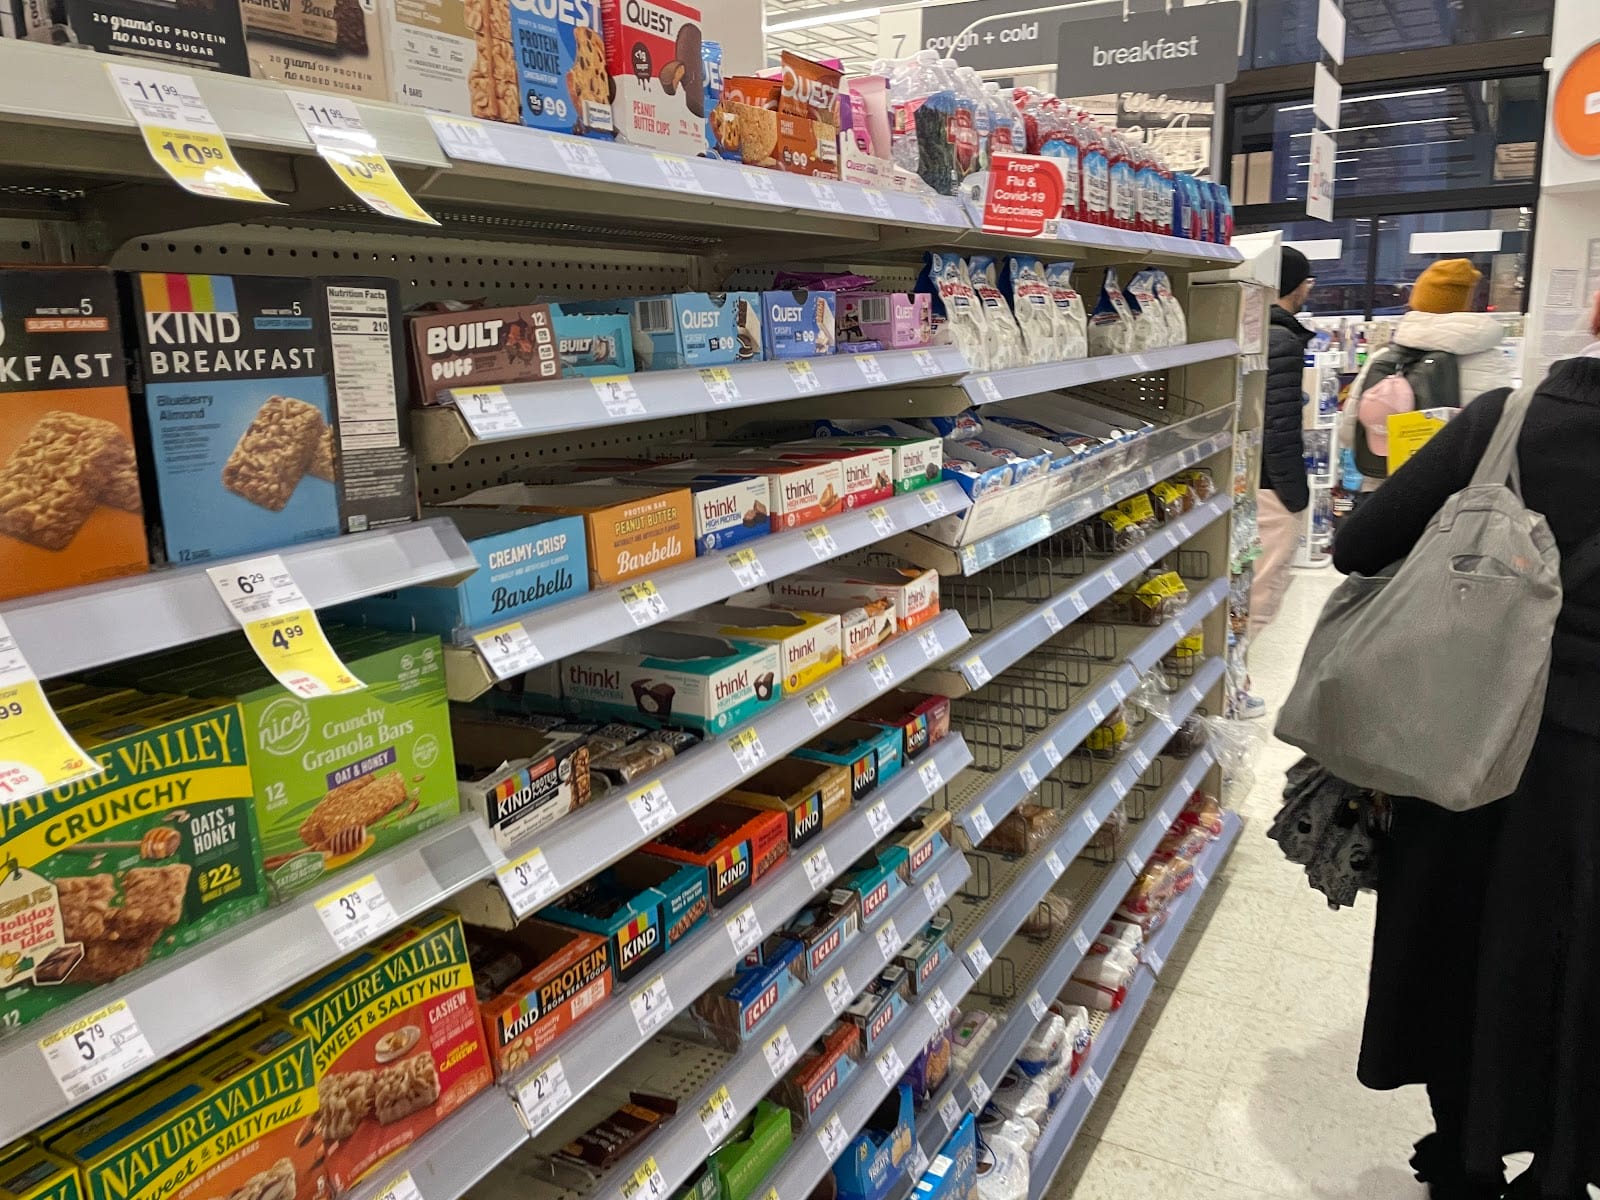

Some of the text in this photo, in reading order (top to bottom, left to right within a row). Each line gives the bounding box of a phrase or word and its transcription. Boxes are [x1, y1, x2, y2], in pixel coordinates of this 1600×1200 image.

[93, 12, 226, 45] 20 grams OF PROTEIN
[626, 0, 673, 35] QUEST
[112, 31, 214, 57] no ADDED SUGAR
[519, 29, 558, 50] PROTEIN
[926, 31, 980, 53] cough
[1000, 22, 1039, 44] cold
[1092, 35, 1199, 68] breakfast
[283, 56, 316, 72] grams
[333, 67, 372, 82] PROTEIN
[522, 48, 561, 76] COOKIE
[300, 75, 330, 87] ADDED
[334, 80, 362, 92] SUGAR
[402, 84, 423, 99] 4 BARS
[633, 101, 656, 117] PEANUT
[633, 115, 671, 136] BUTTER CUPS
[994, 188, 1046, 203] Covid-19
[1006, 176, 1037, 188] Flu &
[992, 203, 1044, 217] Vaccines
[80, 298, 93, 316] 5
[329, 288, 385, 300] Nutrition Facts
[292, 301, 302, 316] 5
[682, 310, 720, 329] QUEST
[772, 304, 803, 322] QUEST
[145, 312, 241, 344] KIND
[372, 321, 388, 333] 210
[427, 320, 503, 355] BUILT
[559, 338, 593, 354] BUILT
[0, 353, 112, 382] KFAST
[150, 348, 316, 375] BREAKFAST
[431, 358, 473, 381] PUFF
[157, 395, 214, 408] Blueberry
[160, 408, 205, 421] Almond
[846, 464, 870, 483] think!
[786, 478, 814, 500] think!
[615, 507, 677, 536] PEANUT BUTTER
[624, 500, 667, 518] PROTEIN BAR
[703, 496, 737, 520] think!
[705, 512, 743, 529] HIGH PROTEIN
[179, 548, 191, 563] 12
[489, 534, 567, 571] CREAMY-CRISP
[617, 536, 681, 575] Barebells
[491, 567, 573, 614] Barebells
[907, 585, 926, 606] think!
[850, 618, 876, 645] think!
[788, 637, 816, 663] think!
[569, 665, 620, 689] think!
[715, 669, 749, 700] think!
[322, 706, 386, 741] Crunchy
[302, 719, 415, 772] Granola Bars
[908, 729, 927, 749] KIND
[0, 713, 231, 838] ATURE VALLEY
[335, 752, 389, 785] OAT & HONEY
[532, 770, 558, 788] PROTEIN
[854, 767, 875, 792] KIND
[265, 782, 286, 802] 12
[498, 787, 532, 820] KIND
[45, 777, 192, 848] CRUNCHY
[190, 808, 225, 837] OATS
[795, 811, 819, 839] KIND
[193, 821, 236, 855] HONEY
[720, 861, 746, 889] KIND
[867, 883, 889, 917] CLIF
[0, 917, 54, 945] Recipe
[20, 930, 56, 951] Idea
[622, 927, 656, 963] KIND
[817, 931, 840, 963] CLIF
[302, 967, 384, 1044] NATURE
[384, 923, 458, 980] VALLEY
[540, 945, 607, 1006] PROTEIN
[542, 995, 565, 1015] FROM
[566, 981, 584, 999] REAL
[585, 965, 606, 983] FOOD
[753, 984, 778, 1022] CLIF
[3, 1010, 21, 1029] 12
[428, 990, 467, 1025] CASHEW
[874, 1005, 894, 1034] CLIF
[316, 970, 461, 1074] SWEET & SALTY NUT
[504, 1007, 539, 1044] KIND
[215, 1047, 307, 1122] VALLEY
[813, 1069, 838, 1105] CLIF
[215, 1097, 303, 1156] SALTY nut
